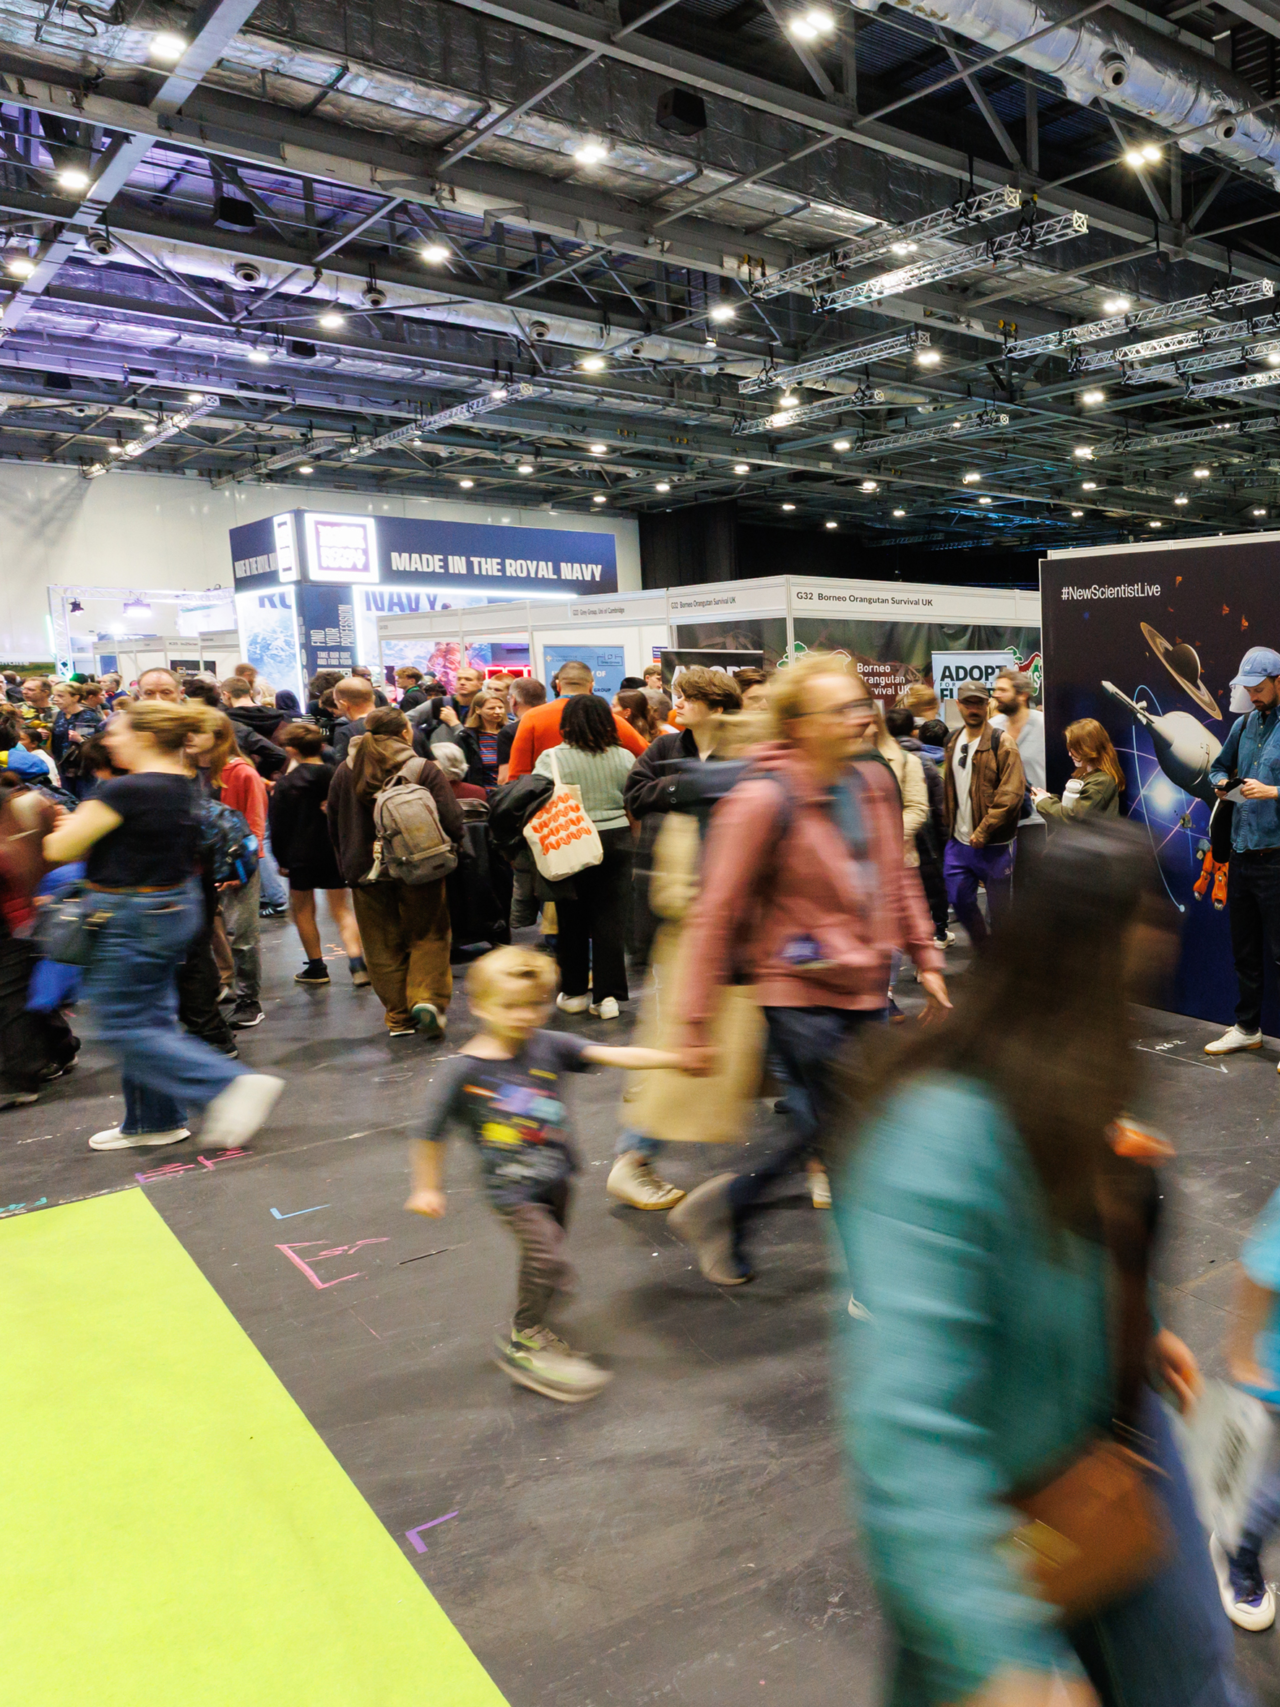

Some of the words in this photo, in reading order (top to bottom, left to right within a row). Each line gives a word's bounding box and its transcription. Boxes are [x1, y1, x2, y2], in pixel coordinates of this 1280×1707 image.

[390, 552, 444, 573] MADE
[447, 555, 467, 574] IN
[470, 557, 502, 576] THE
[505, 558, 557, 579] ROYAL
[560, 562, 602, 581] NAVY
[796, 591, 814, 600] G32
[817, 593, 847, 602] Borneo
[848, 594, 890, 605] Orangutan
[891, 596, 920, 606] Survival
[921, 598, 933, 606] UK
[1061, 582, 1161, 600] #NewScientistLive
[364, 590, 438, 612] NAVY
[338, 604, 355, 647] PROFESSION
[310, 629, 325, 646] FIND
[325, 627, 340, 647] YOUR
[857, 662, 890, 673] Borneo
[897, 685, 911, 695] UK
